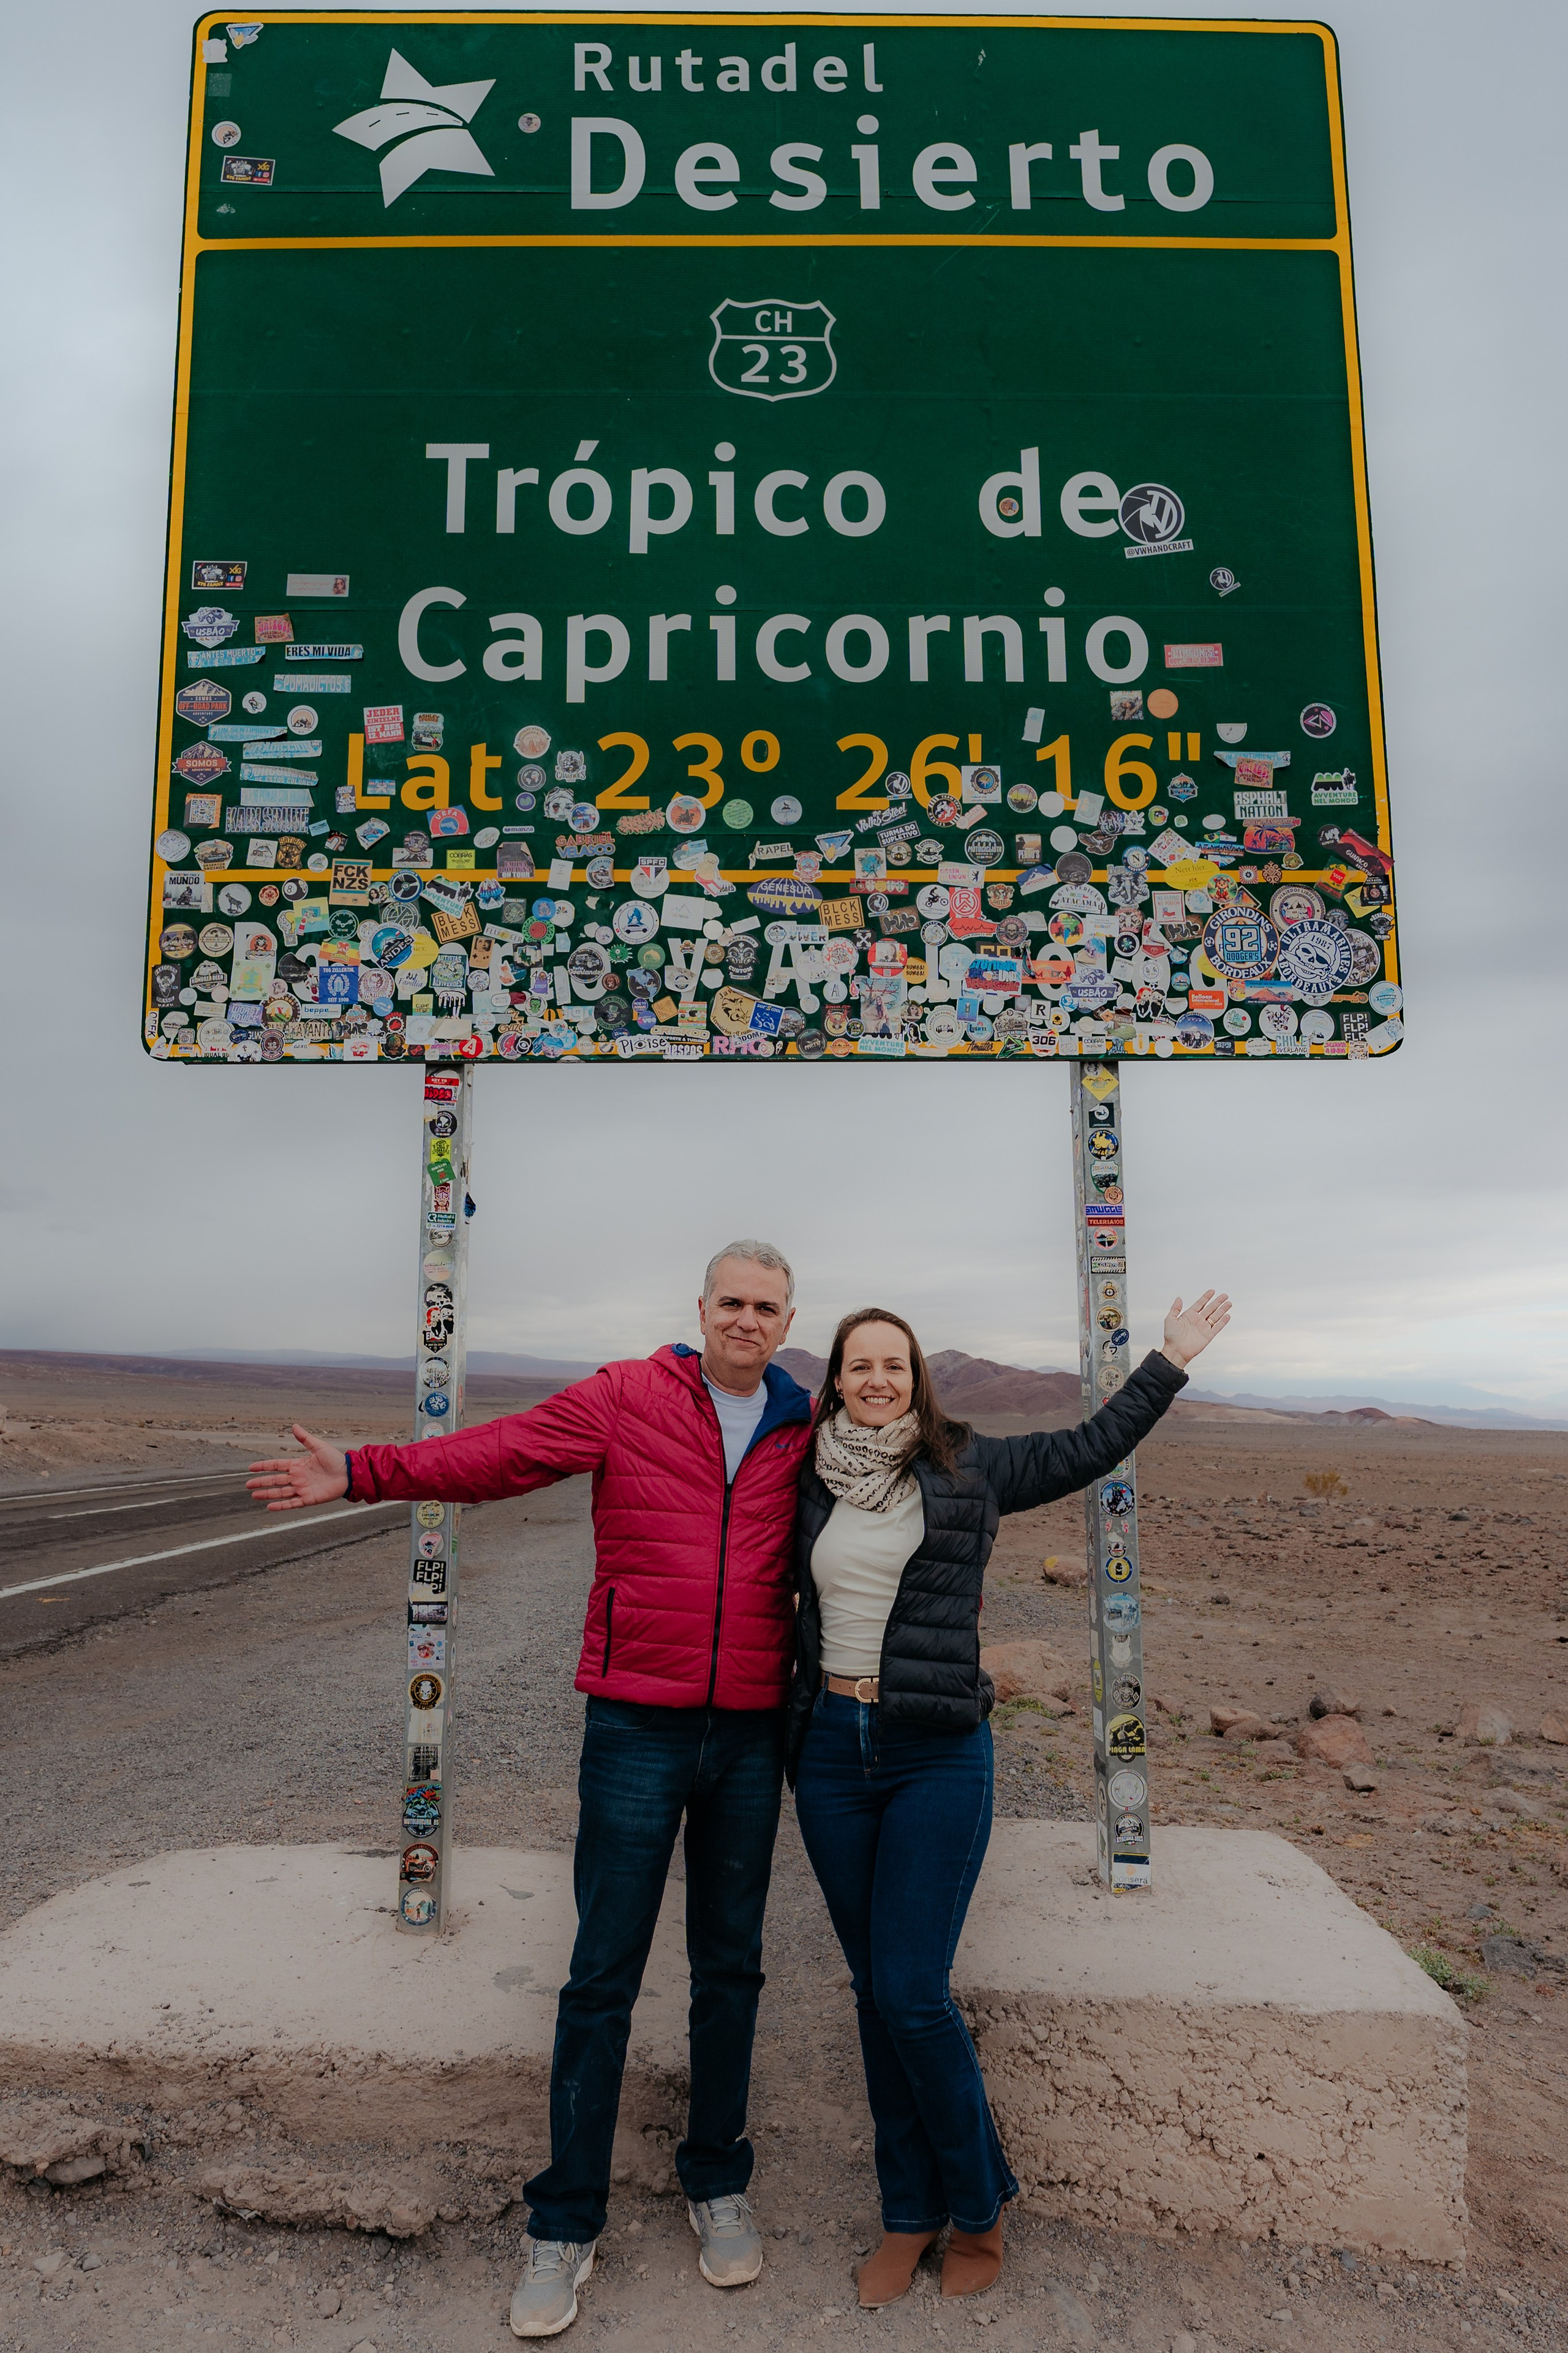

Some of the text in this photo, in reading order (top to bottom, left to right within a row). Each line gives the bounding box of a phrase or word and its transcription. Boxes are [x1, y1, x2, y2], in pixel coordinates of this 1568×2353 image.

[571, 115, 1214, 212] Desierto
[755, 310, 792, 333] CH
[741, 344, 807, 384] 23
[426, 440, 1121, 554] Trópico de
[1126, 542, 1191, 556] @VWHANDCRAFT
[398, 584, 1149, 703] Capricornio
[201, 649, 257, 660] ANTES MUERTO
[287, 646, 351, 657] ERES MI VIDA
[367, 708, 400, 717] JEDER
[367, 716, 401, 724] EINZELNE
[384, 723, 402, 731] DER
[379, 730, 402, 738] MANN
[347, 733, 503, 811] Lat
[1234, 790, 1287, 805] ASPHALT
[435, 809, 458, 820] UEFA
[882, 801, 908, 823] Steel
[1240, 805, 1284, 818] NATION
[556, 832, 615, 847] GABRIEL
[880, 828, 905, 839] TURMA
[881, 830, 919, 845] SUPLETIVO
[556, 843, 616, 858] VELASCO
[1346, 849, 1368, 867] GUANACO
[334, 864, 369, 878] FCK
[1175, 865, 1191, 874] Nett
[169, 877, 200, 885] MUNDO
[333, 878, 369, 890] NZS
[761, 883, 811, 895] GENESUR
[1278, 888, 1316, 901] VIAJEROS LIBRES
[423, 889, 463, 912] AVVENTURE
[1060, 897, 1098, 907] ATACAMA
[434, 900, 461, 917] MONDO
[823, 901, 858, 915] BLCK
[438, 906, 474, 926] BLK
[824, 912, 860, 927] MESS
[1210, 906, 1273, 932] GIRONDINS
[440, 919, 477, 939] MESS
[1224, 927, 1259, 951] 92
[1310, 934, 1333, 950] 1987
[380, 935, 414, 967] ANDES
[1281, 920, 1351, 975] ULTRAMARINES
[728, 965, 753, 974] CUSTOM
[1210, 954, 1273, 979] BORDEAUX
[1278, 953, 1336, 993] BORDEAUX
[232, 1004, 260, 1016] WORST
[1036, 1004, 1046, 1016] R
[1343, 1013, 1368, 1023] FLP!
[1343, 1023, 1369, 1032] FLP!
[859, 1038, 905, 1048] AVVENTURE
[1032, 1035, 1056, 1046] 306
[1276, 1035, 1308, 1047] CHILE
[1344, 1032, 1365, 1041] FLP
[873, 1045, 904, 1054] MONDO
[417, 1561, 444, 1571] FLP!
[417, 1572, 443, 1582] FLP!
